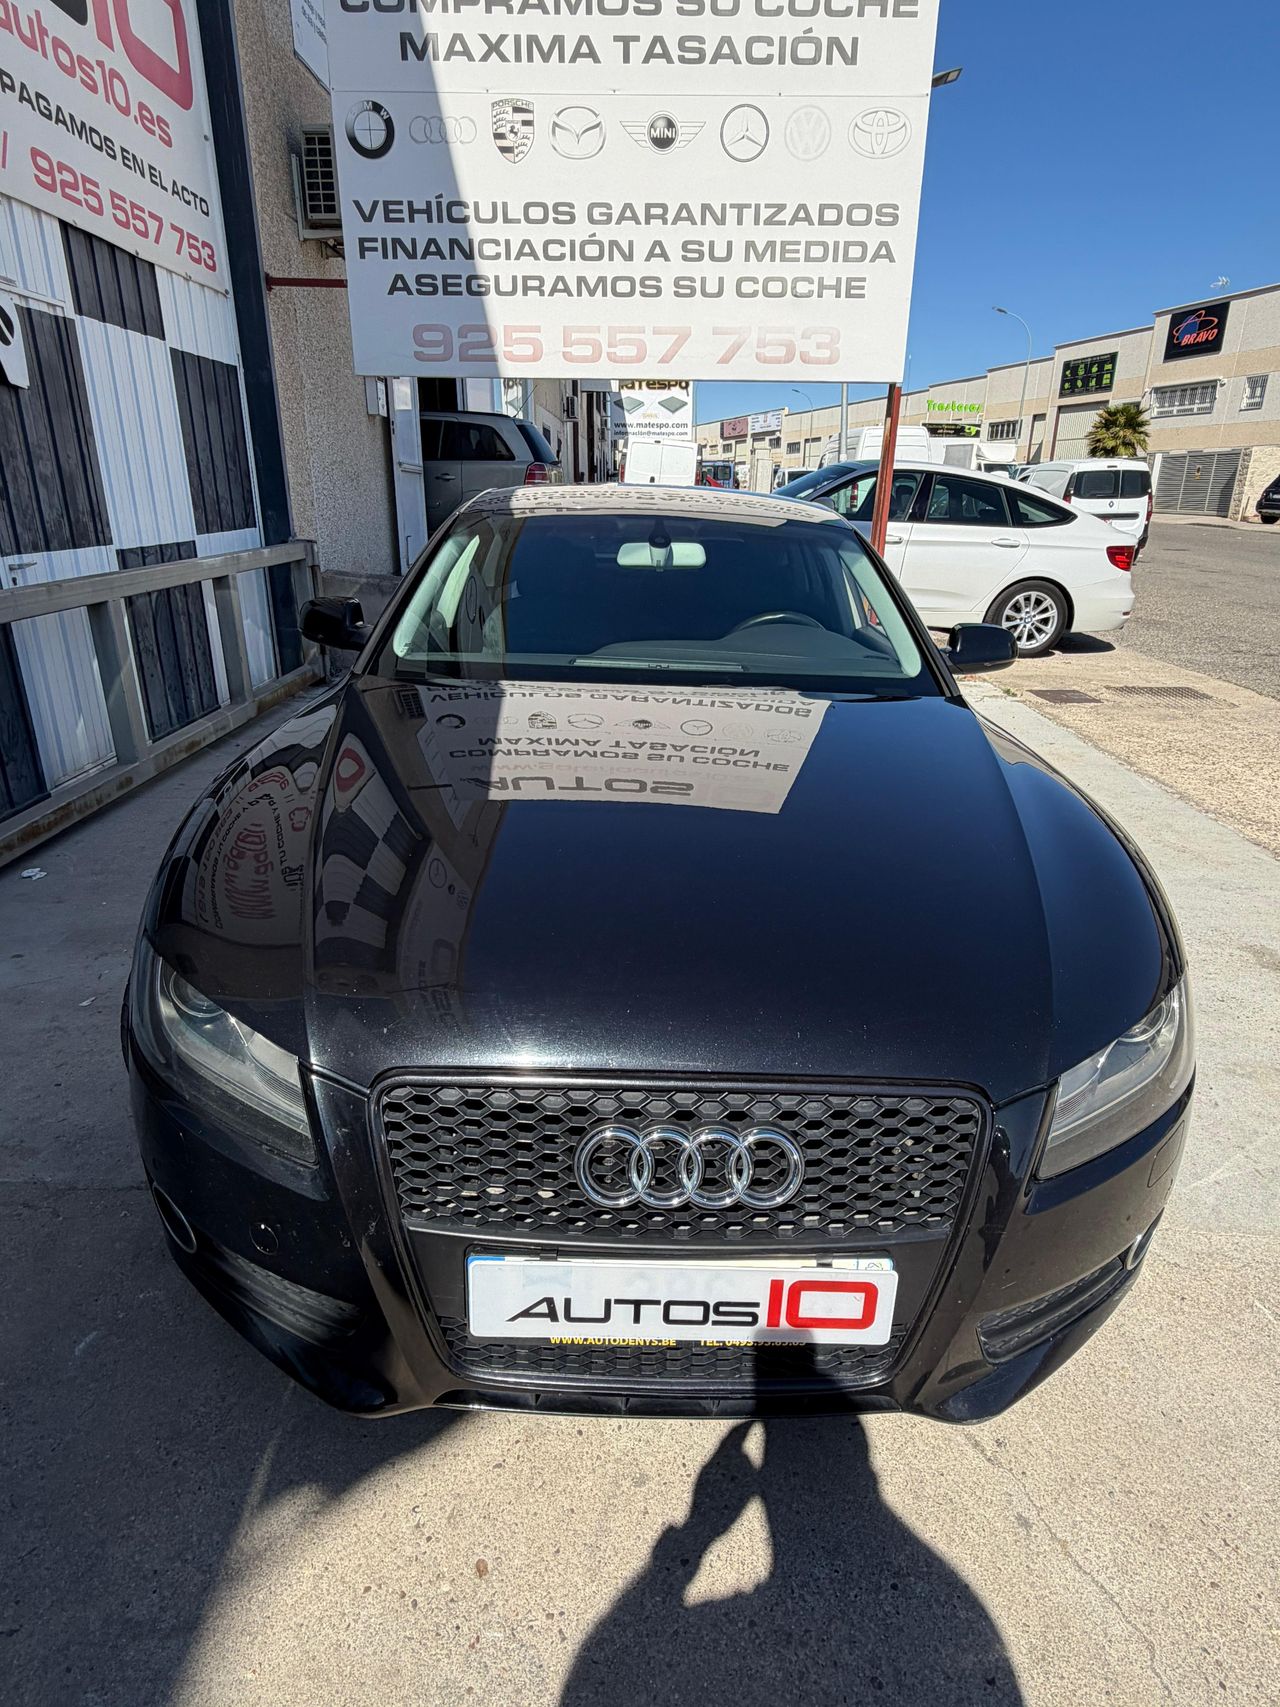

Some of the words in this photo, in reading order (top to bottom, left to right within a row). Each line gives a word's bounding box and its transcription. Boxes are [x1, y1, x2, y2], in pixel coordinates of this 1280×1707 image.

[400, 32, 601, 64] MAXIMA
[613, 26, 859, 66] TASACIÓN
[650, 126, 676, 139] MINI
[119, 144, 146, 180] EN
[148, 162, 169, 192] EL
[171, 179, 210, 217] ACTO
[30, 146, 104, 216] 925
[109, 188, 164, 245] 557
[169, 222, 217, 273] 753
[352, 193, 576, 225] VEHÍCULOS
[587, 202, 900, 227] GARANTIZADOS
[358, 232, 634, 262] FINANCIACIÓN
[644, 240, 671, 262] A
[681, 240, 733, 263] SU
[744, 240, 896, 263] MEDIDA
[387, 273, 663, 298] ASEGURAMOS
[673, 276, 724, 298] SU
[735, 276, 867, 299] COCHE
[412, 323, 544, 363] 925
[561, 324, 692, 365] 557
[712, 326, 841, 365] 753
[1180, 329, 1218, 347] BRAVO
[613, 421, 688, 430] www.matespo.com
[550, 1335, 677, 1347] WWW.AUTODENYS.BE
